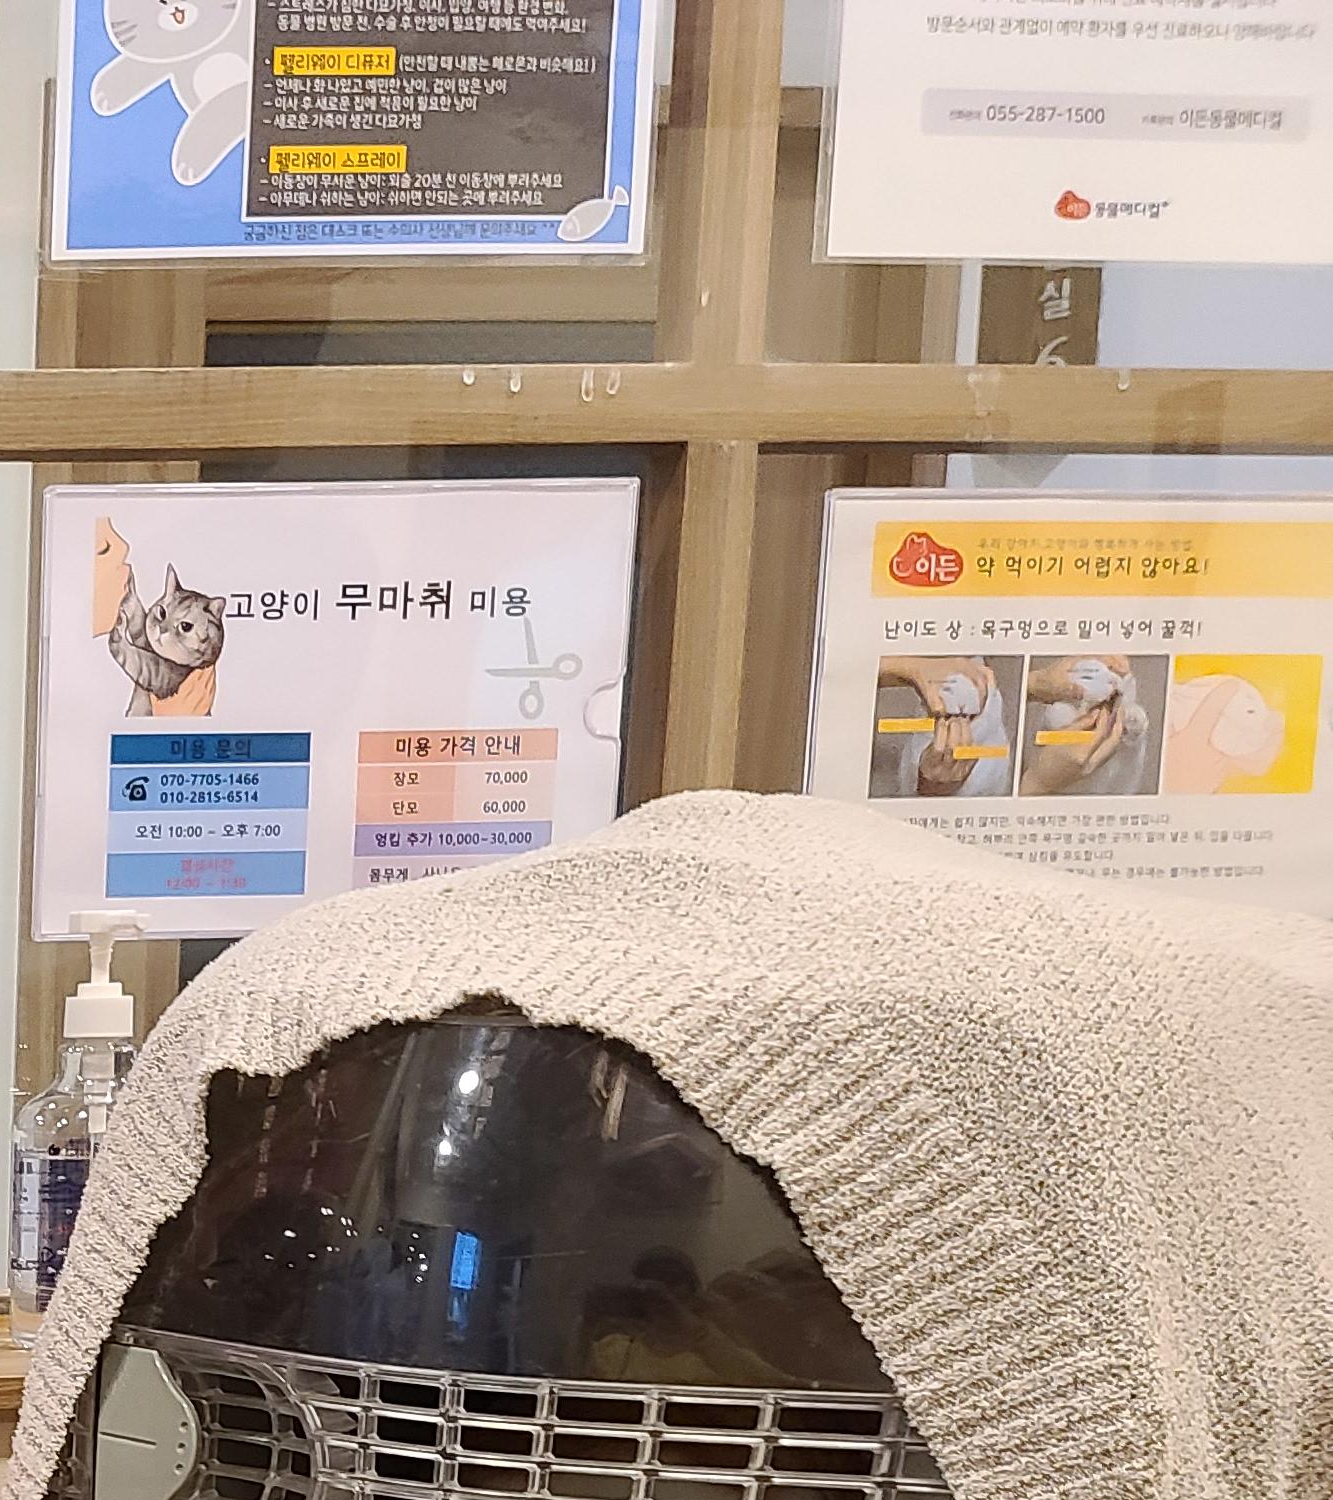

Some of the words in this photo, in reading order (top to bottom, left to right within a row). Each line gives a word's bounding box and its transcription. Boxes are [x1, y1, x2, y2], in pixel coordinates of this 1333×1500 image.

[986, 104, 1106, 124] 055-287-1500
[340, 152, 401, 169] 스프레이
[915, 552, 960, 582] 이든
[976, 556, 996, 577] 약
[1005, 555, 1064, 577] 먹이기
[1073, 555, 1131, 578] 어렵지
[1141, 556, 1209, 578] 않아요!
[225, 588, 321, 621] 고양이
[335, 580, 454, 622] 무마취
[470, 586, 532, 618] 미용
[884, 619, 937, 639] 난이도
[945, 619, 963, 639] 상
[981, 619, 1070, 639] 목구멍으로
[1077, 619, 1111, 639] 밀어
[1120, 619, 1153, 639] 넣어
[170, 738, 205, 760] 미용
[216, 738, 251, 760] 문의
[395, 737, 432, 758] 미용
[439, 735, 476, 756] 가격
[484, 735, 521, 756] 안내
[160, 773, 260, 787] 070-7705-1466
[393, 771, 420, 787] 장모
[484, 771, 528, 786] 70,000
[160, 790, 259, 804] 010-2815-6514
[392, 800, 418, 816] 단모
[482, 800, 526, 815] 60,000
[135, 823, 162, 839] 오전
[168, 825, 203, 838] 10:00
[222, 823, 249, 839] 오후
[253, 824, 281, 838] 7:00
[407, 831, 433, 847] 추가
